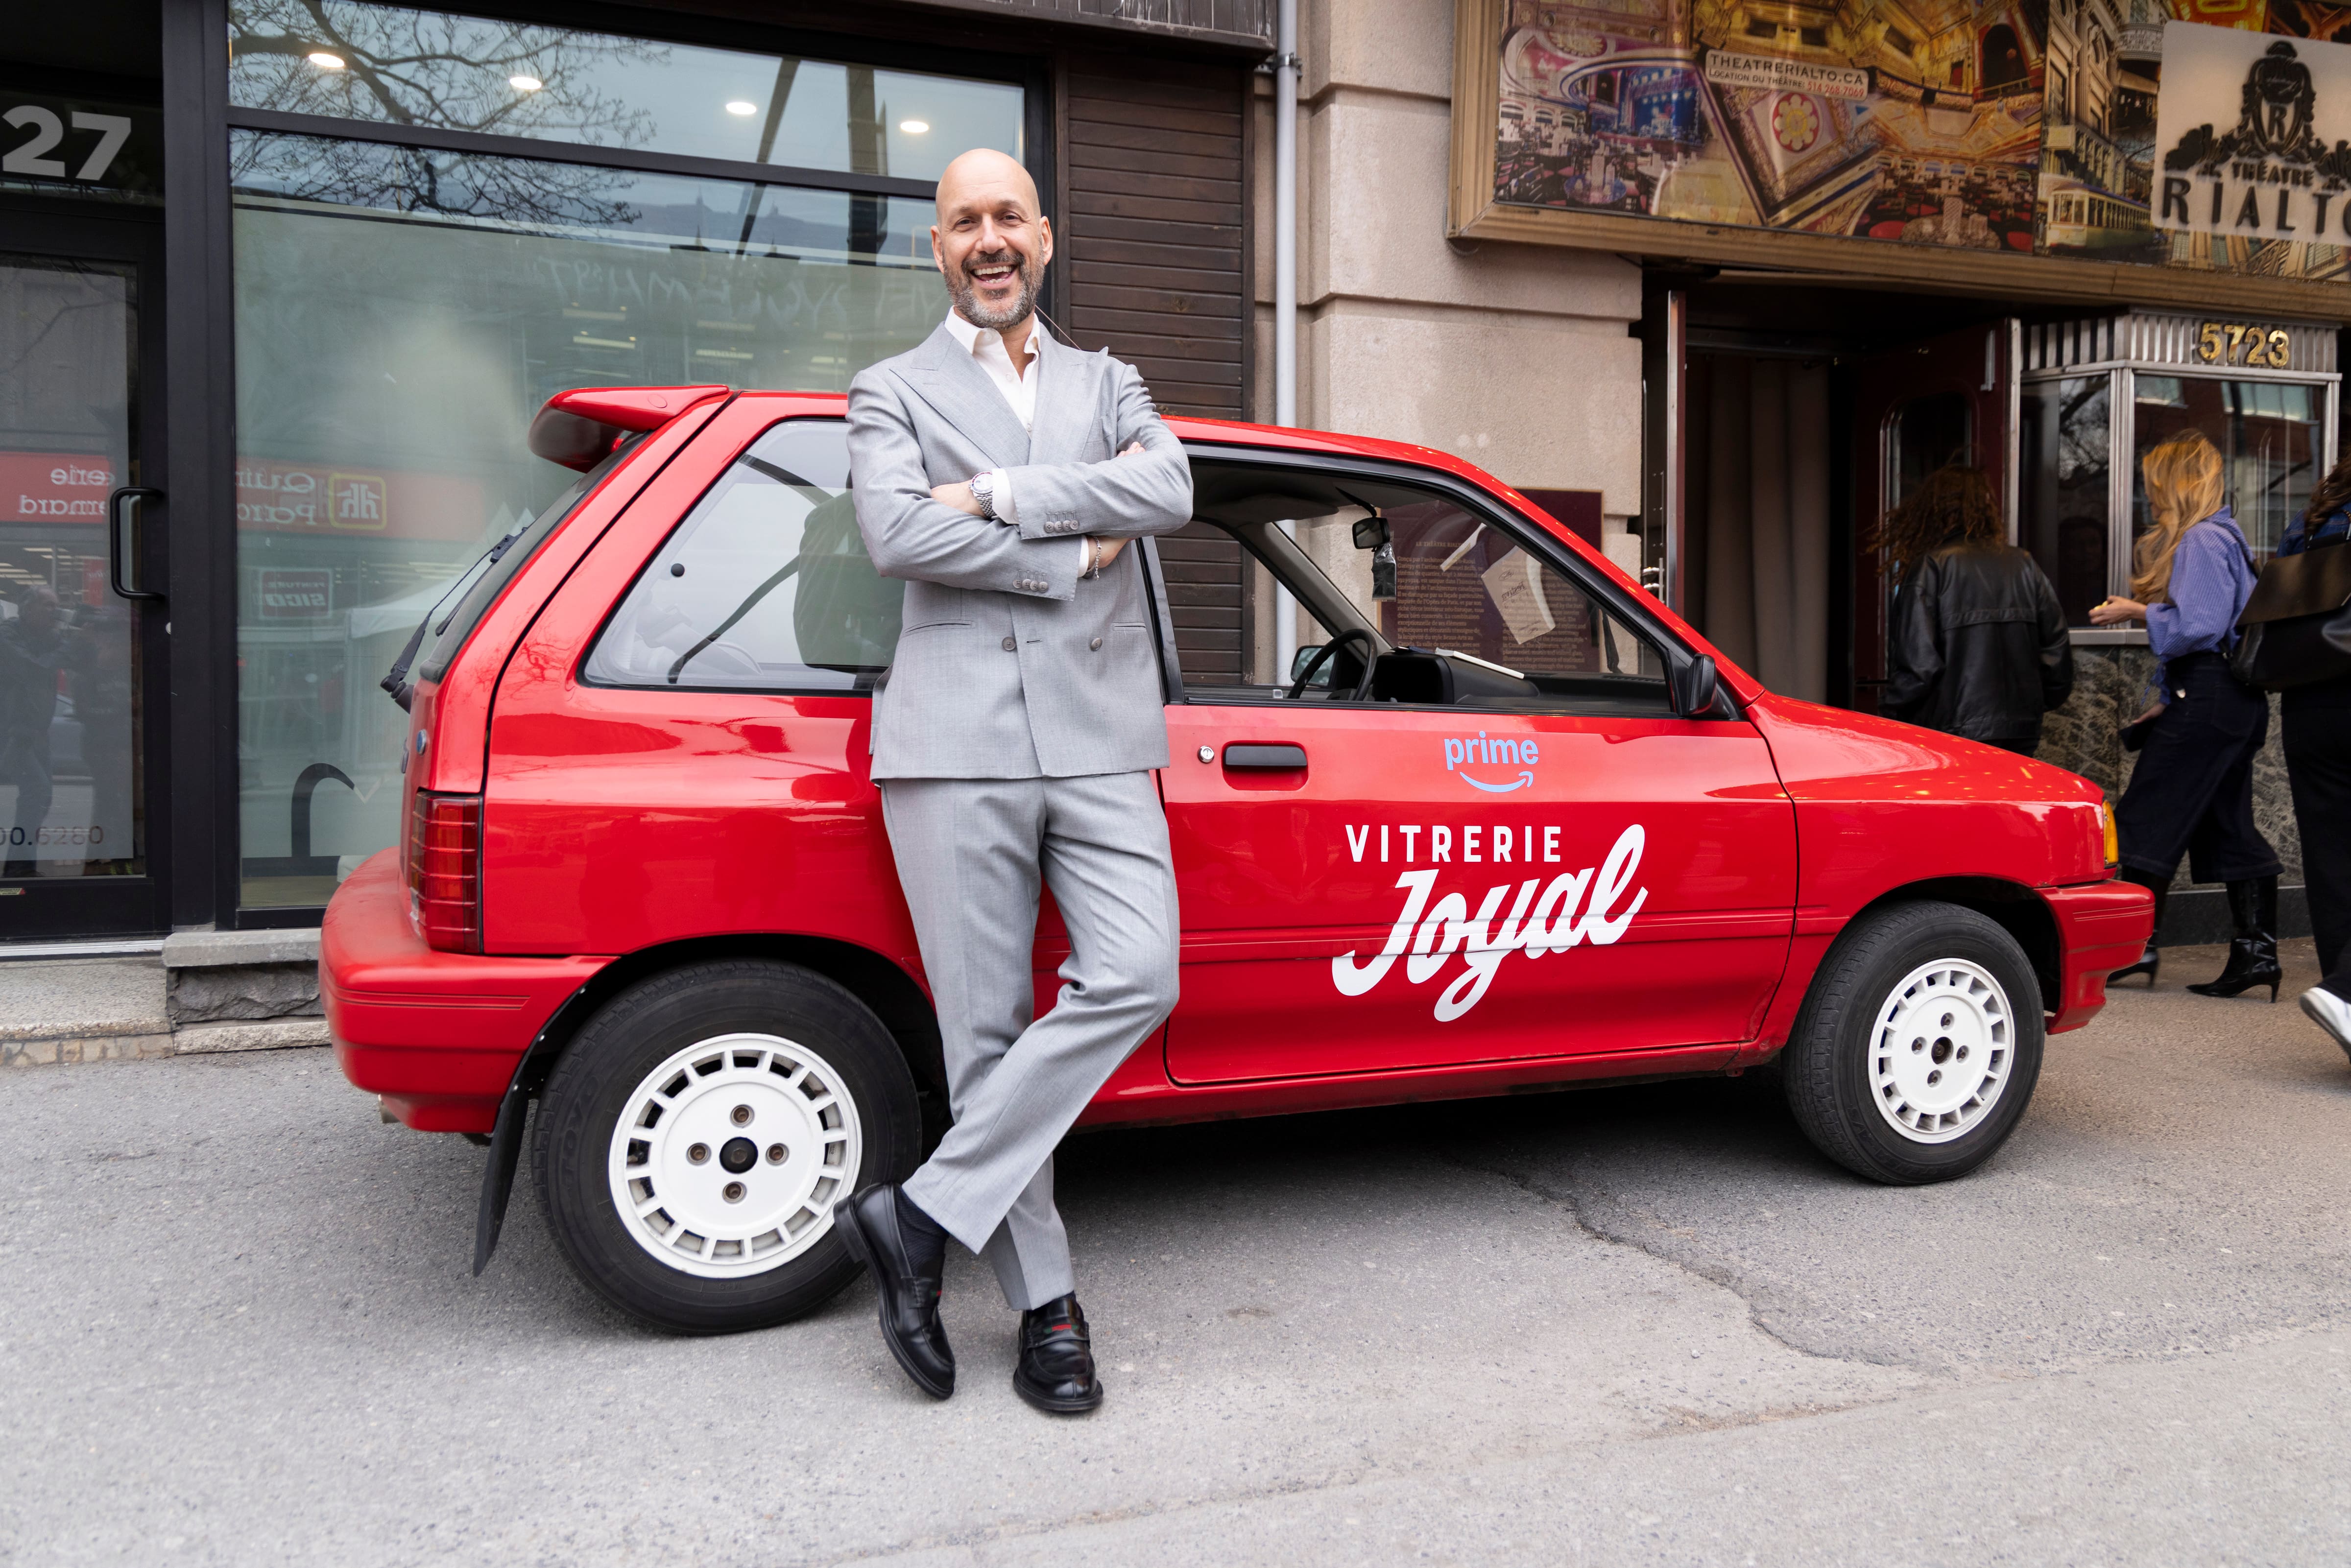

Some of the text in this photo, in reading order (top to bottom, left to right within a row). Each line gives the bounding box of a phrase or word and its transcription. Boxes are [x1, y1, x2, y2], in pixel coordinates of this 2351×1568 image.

[1709, 68, 1750, 83] LOCATION
[1752, 75, 1764, 84] DU
[1807, 81, 1822, 93] 514
[1710, 54, 1864, 85] THEATRERIALTO.CA
[1, 104, 131, 180] 27
[2199, 322, 2289, 368] 5723
[1444, 730, 1539, 771] prime
[1345, 824, 1561, 863] VITRERIE
[1332, 824, 1649, 1022] Joyal
